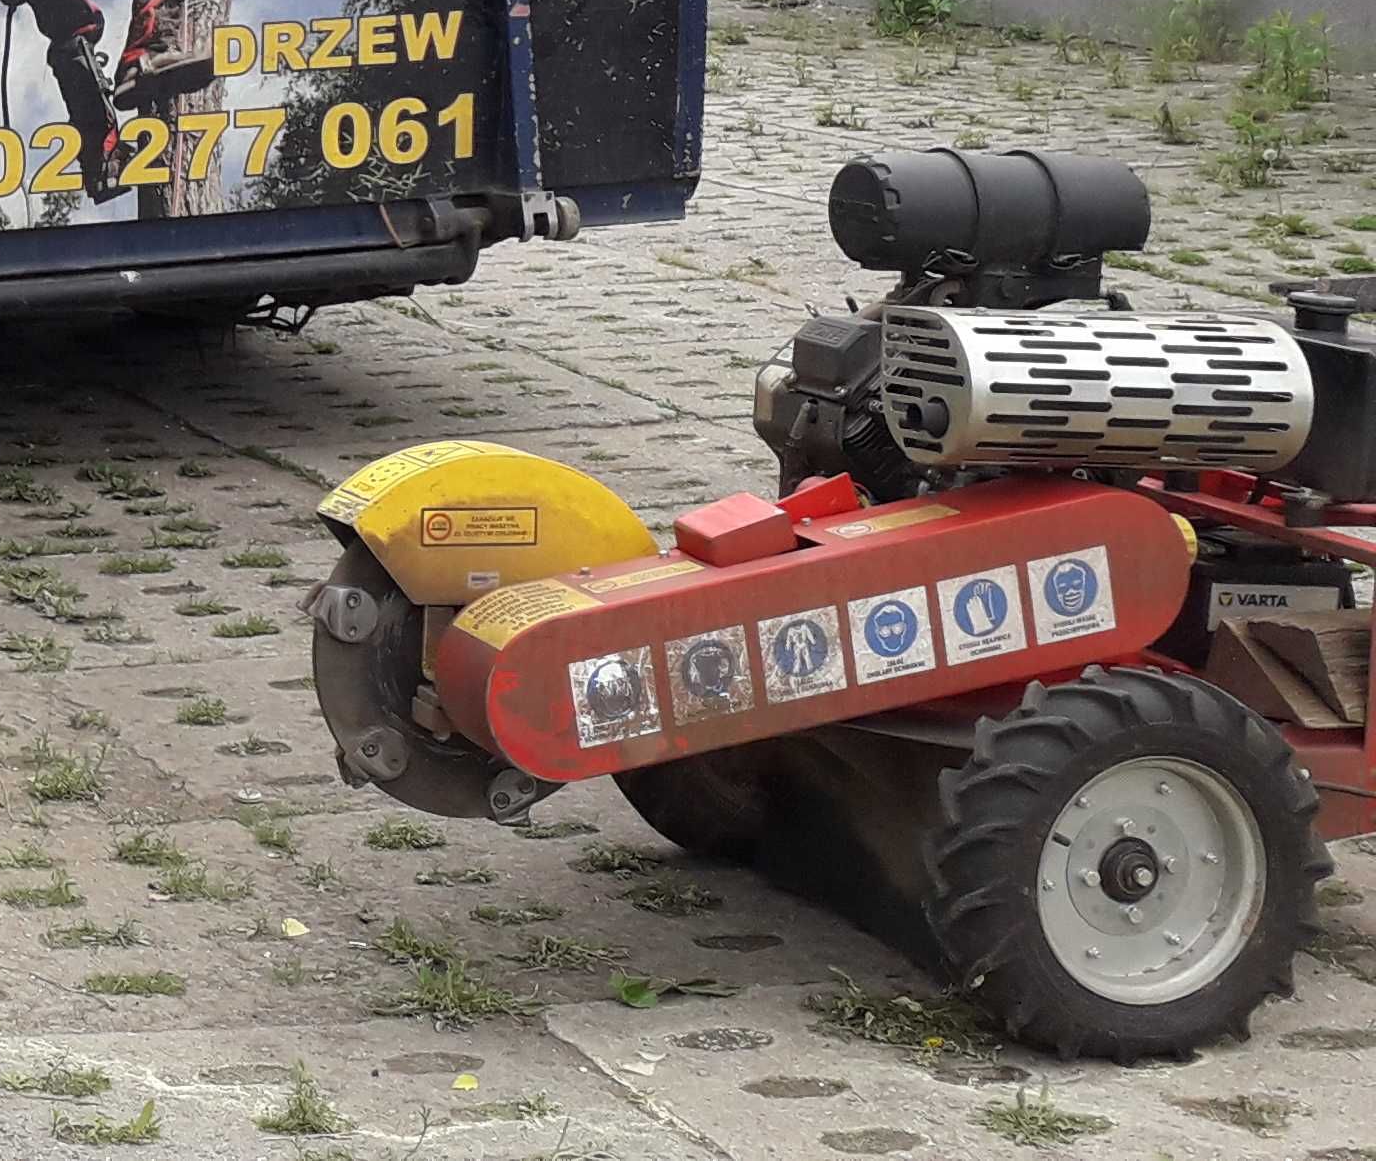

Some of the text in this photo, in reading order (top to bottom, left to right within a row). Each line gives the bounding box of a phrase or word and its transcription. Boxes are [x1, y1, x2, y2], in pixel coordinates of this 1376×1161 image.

[213, 10, 463, 76] DRZEW
[118, 108, 288, 187] 277
[320, 93, 476, 170] 061
[1237, 593, 1289, 608] VARTA
